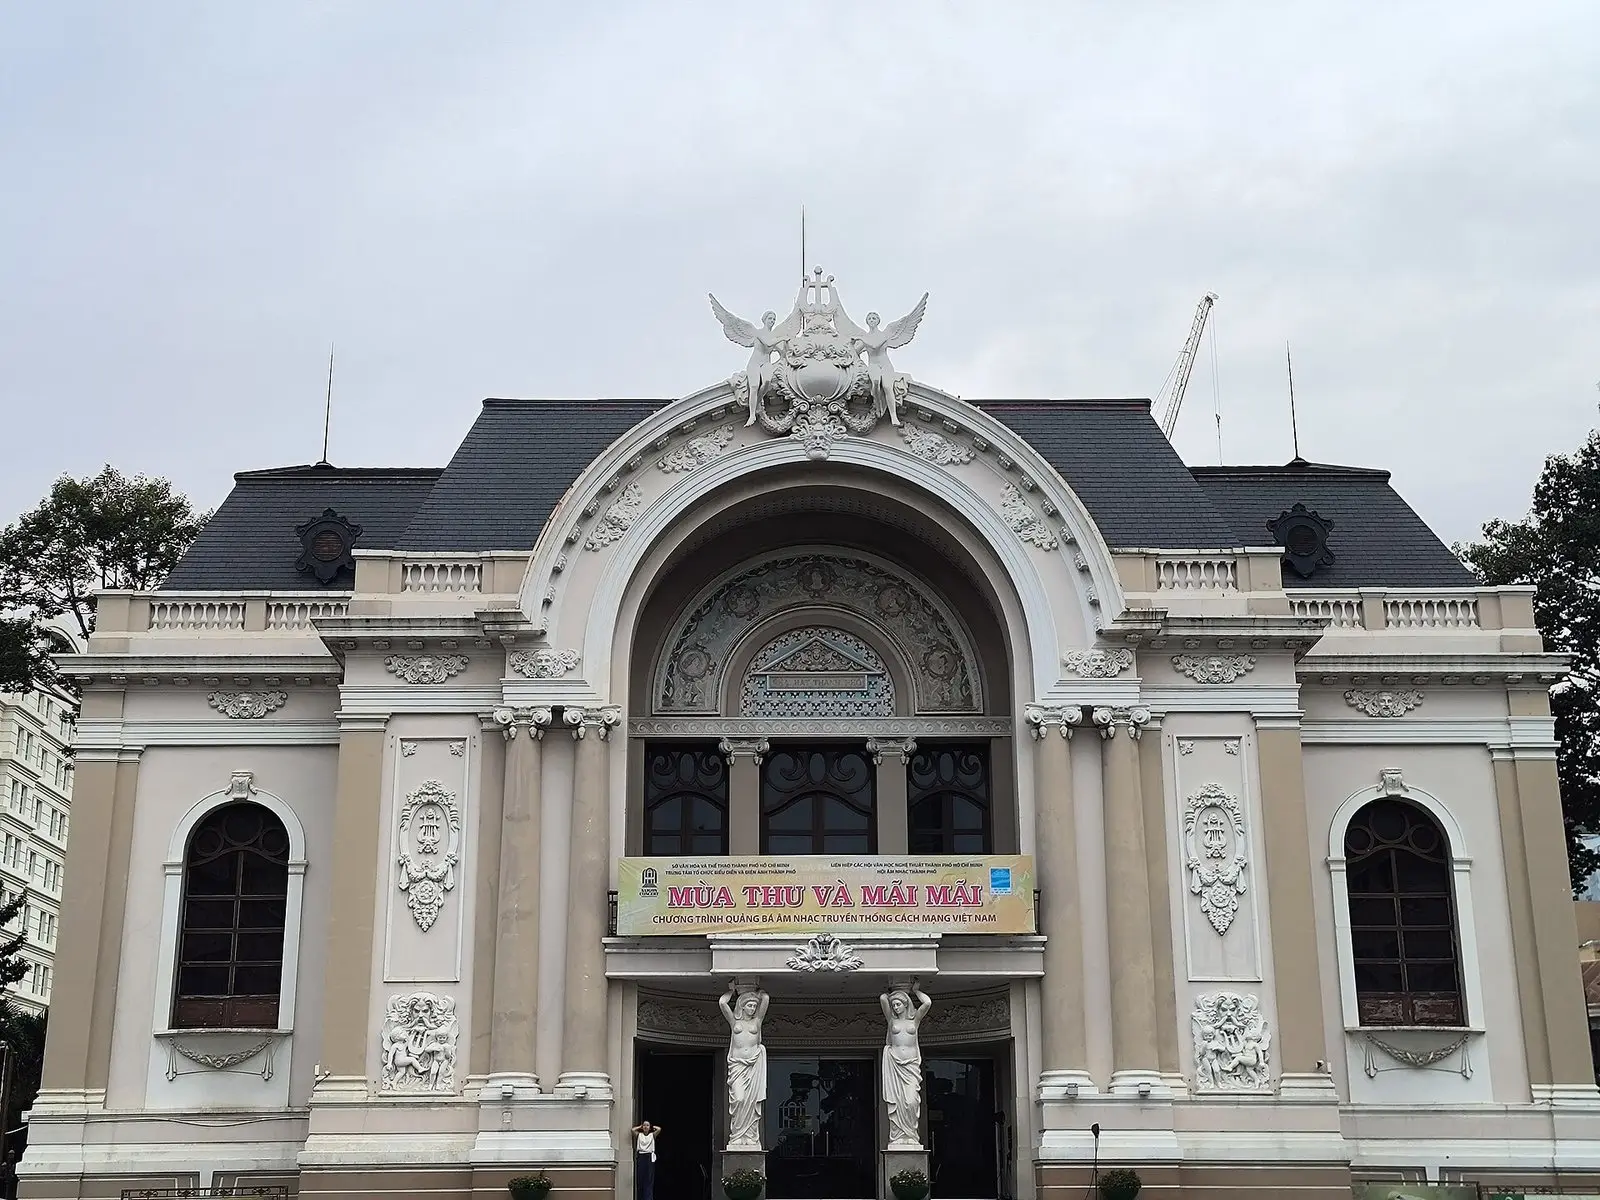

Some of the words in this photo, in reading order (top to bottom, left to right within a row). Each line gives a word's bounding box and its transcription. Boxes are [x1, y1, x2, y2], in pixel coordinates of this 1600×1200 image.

[667, 879, 736, 909] MÙA
[742, 885, 806, 909] THU
[811, 879, 855, 908] VÀ
[860, 879, 918, 908] MÃI
[925, 879, 983, 908] MÃI
[652, 914, 694, 923] CHƯƠNG
[695, 913, 723, 923] TRÌNH
[725, 912, 759, 923] QUẢNG
[761, 913, 776, 923] BÁ
[793, 914, 820, 925] NHẠC
[859, 912, 892, 923] THỐNG
[894, 913, 919, 922] CÁCH
[922, 914, 951, 924] MẠNG
[953, 912, 972, 924] VIỆT
[974, 914, 997, 922] NAM
